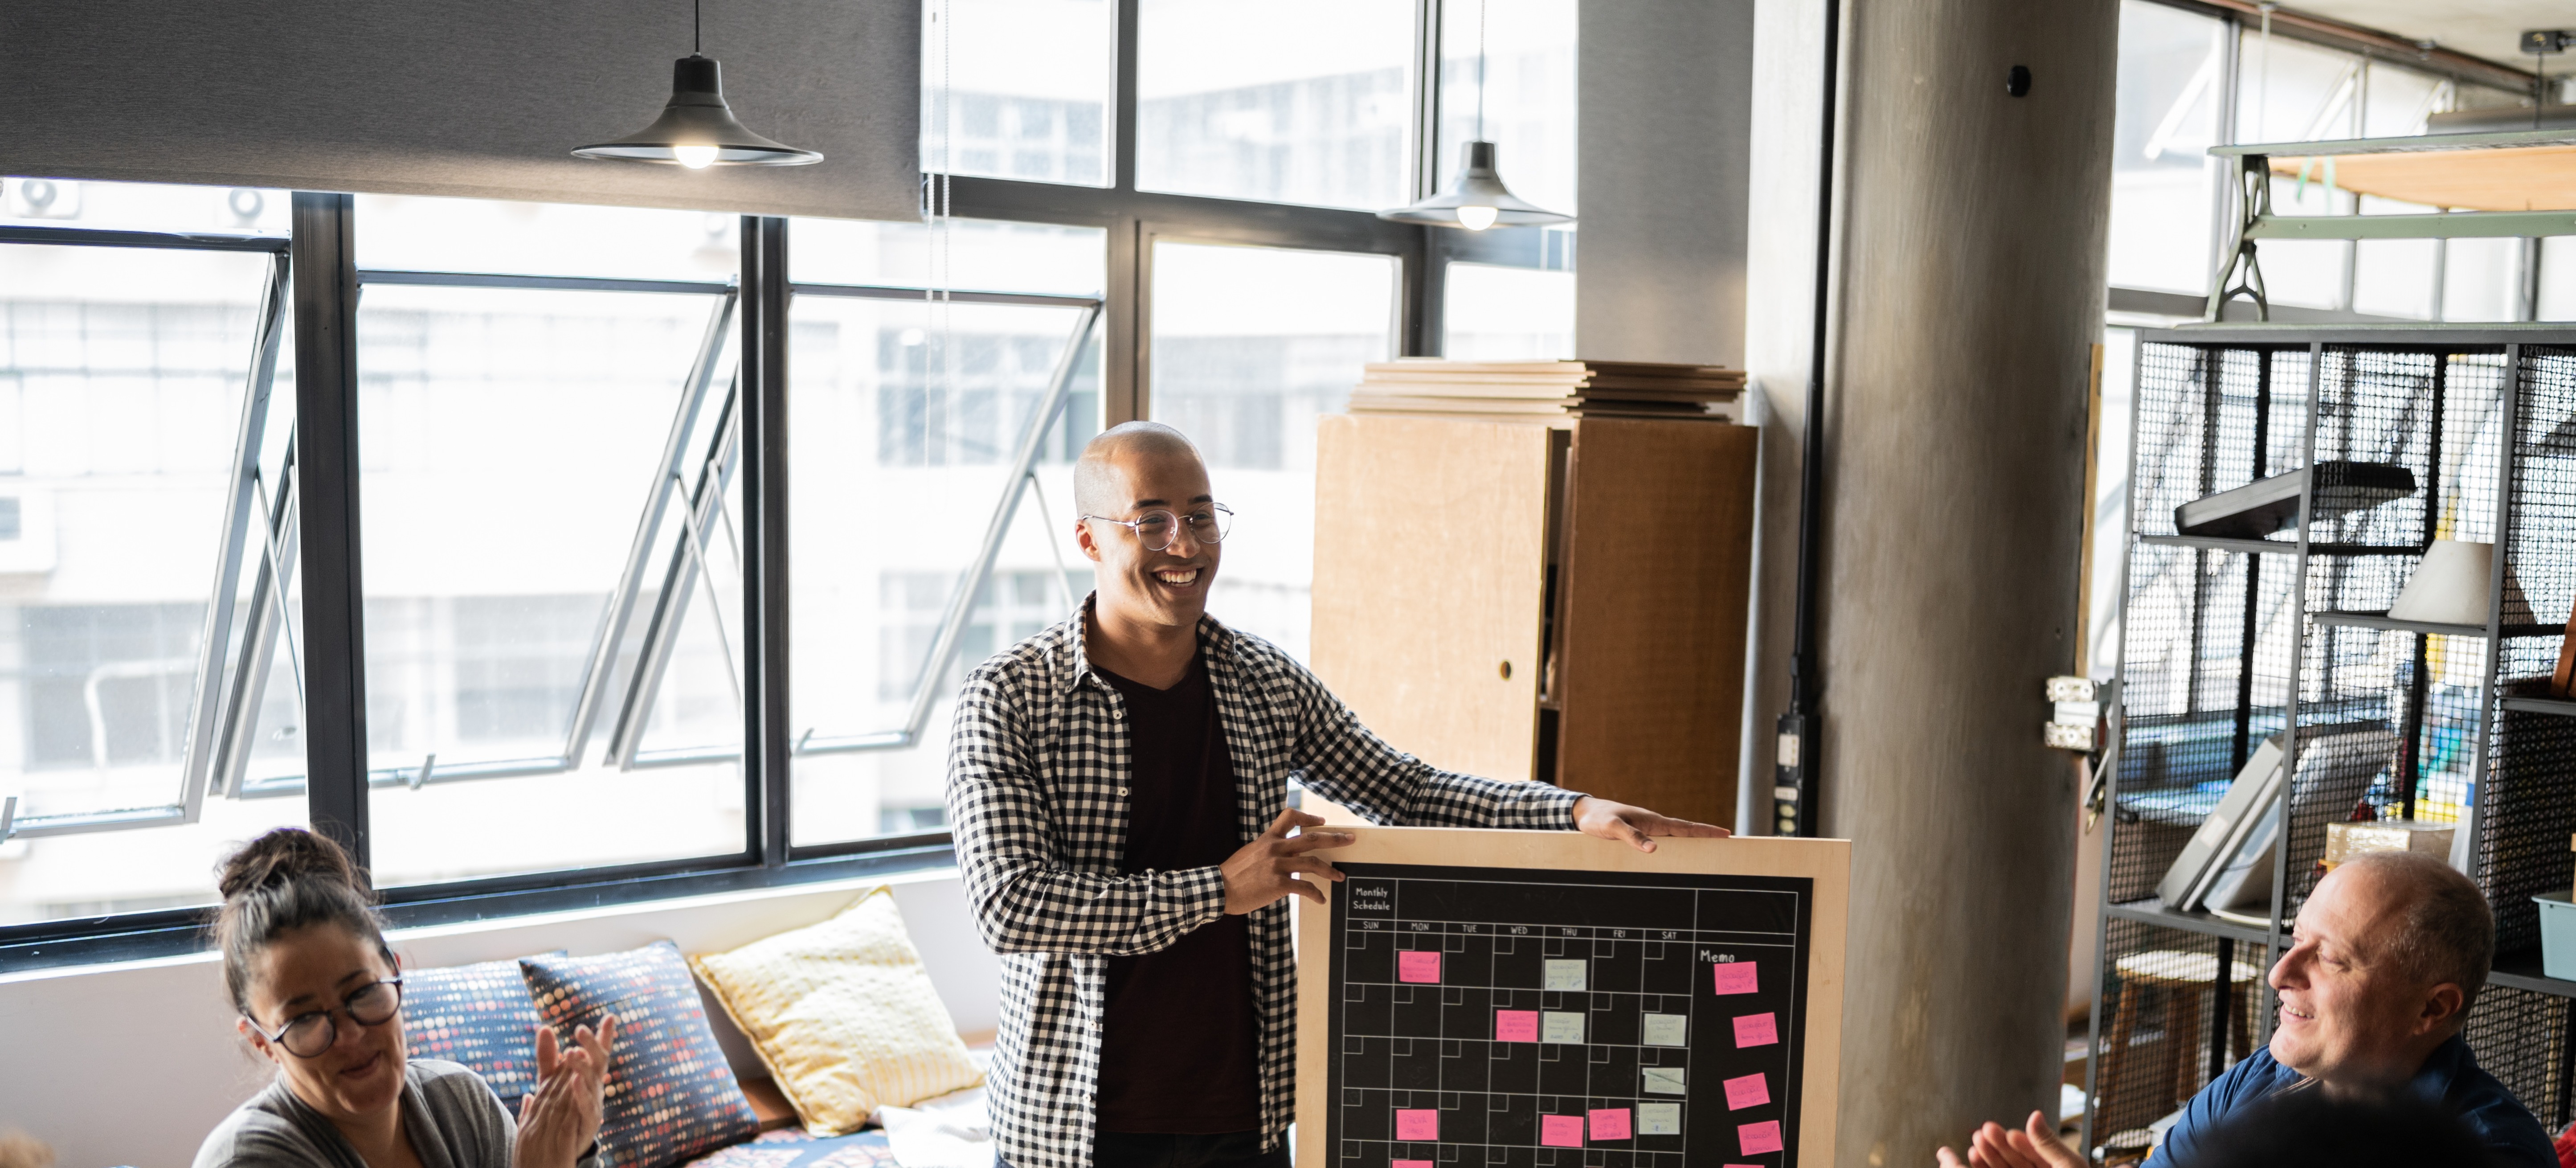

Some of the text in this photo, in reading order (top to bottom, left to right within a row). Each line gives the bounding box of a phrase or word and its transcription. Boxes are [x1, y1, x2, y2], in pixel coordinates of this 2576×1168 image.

[1356, 887, 1388, 898] Monthly
[1353, 900, 1390, 910] Schedule
[1363, 921, 1379, 929] SUN
[1411, 922, 1429, 931] MON
[1462, 924, 1477, 933] TUE
[1510, 926, 1528, 934] WED
[1562, 928, 1577, 936] THU
[1613, 930, 1626, 938] FRI
[1662, 931, 1677, 940] SAT
[1700, 950, 1735, 963] Memo
